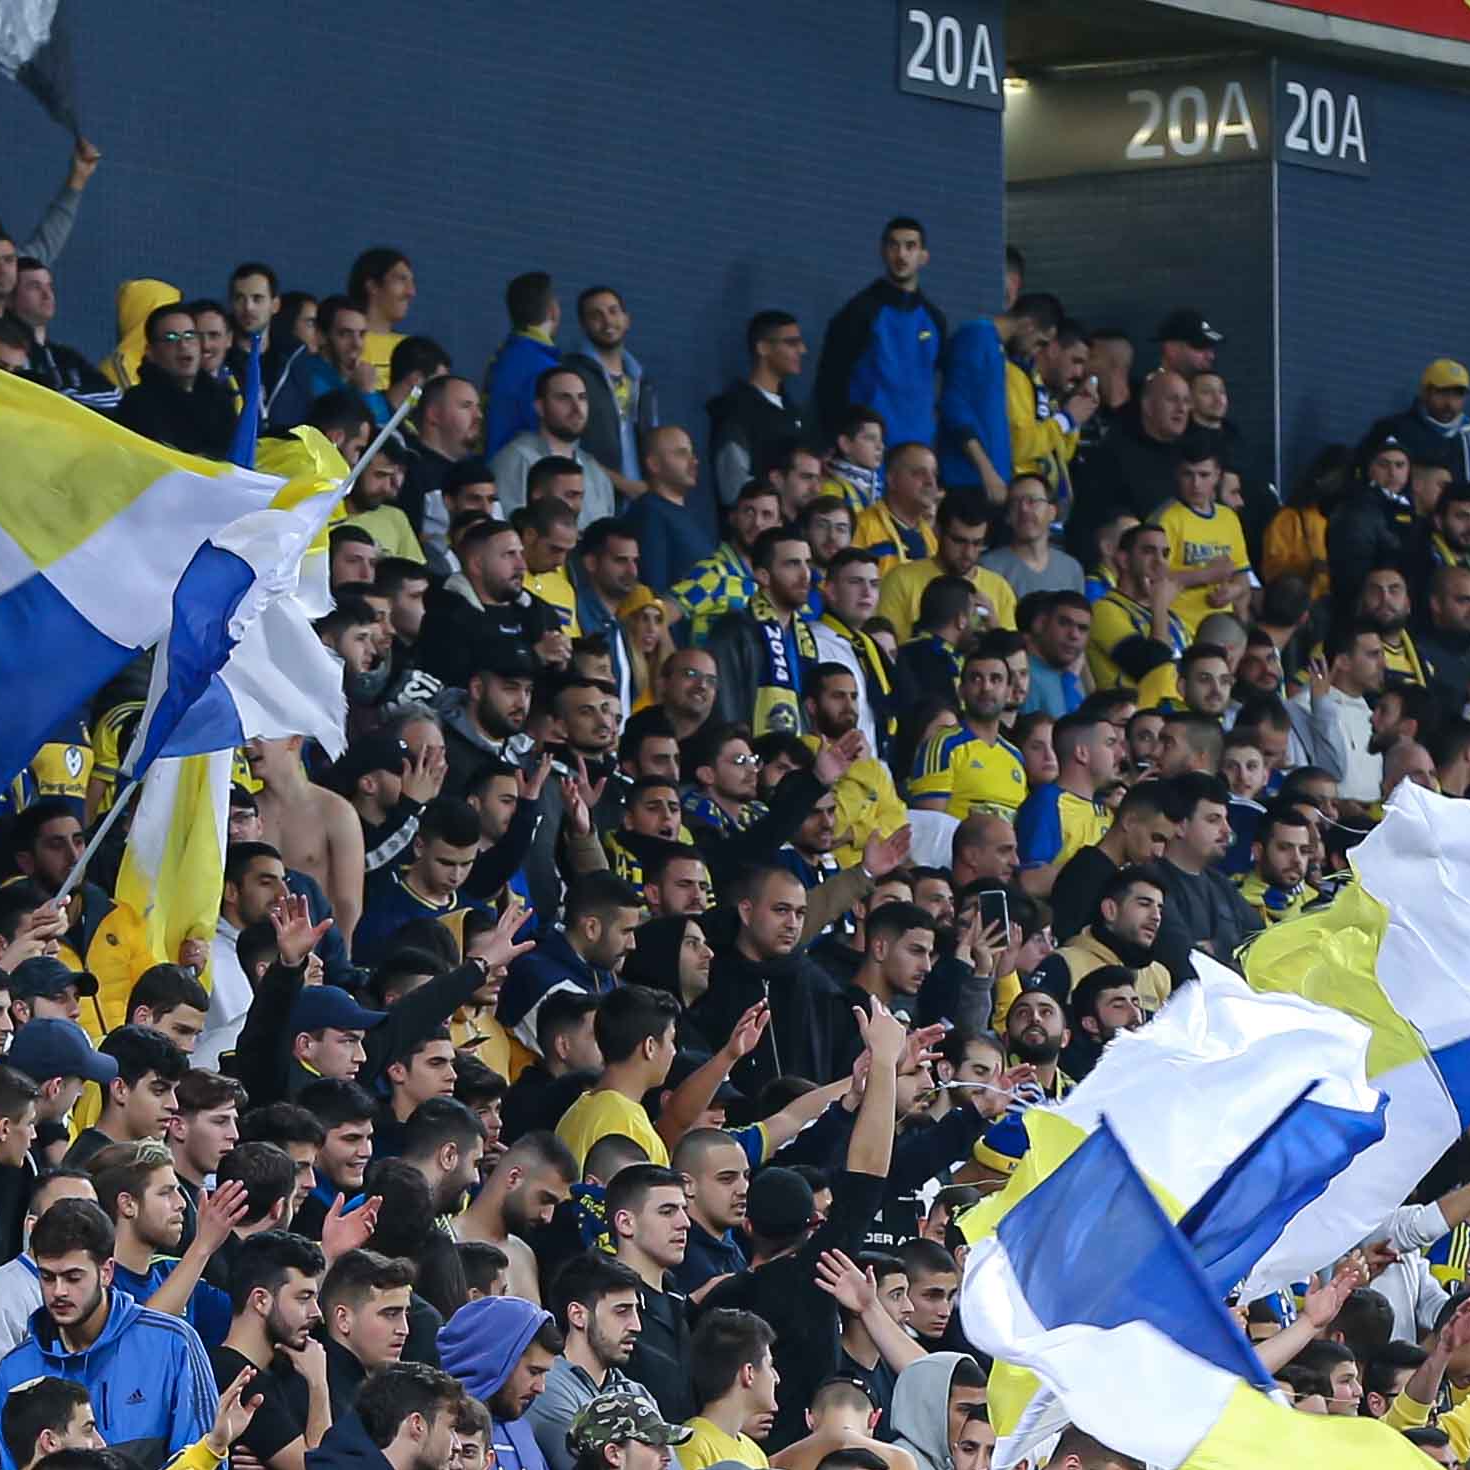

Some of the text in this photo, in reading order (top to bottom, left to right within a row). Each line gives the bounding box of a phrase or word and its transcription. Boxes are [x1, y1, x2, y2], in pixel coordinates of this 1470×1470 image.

[906, 9, 1000, 95] 20A
[1125, 81, 1258, 160] 20A
[1284, 80, 1368, 164] 20A
